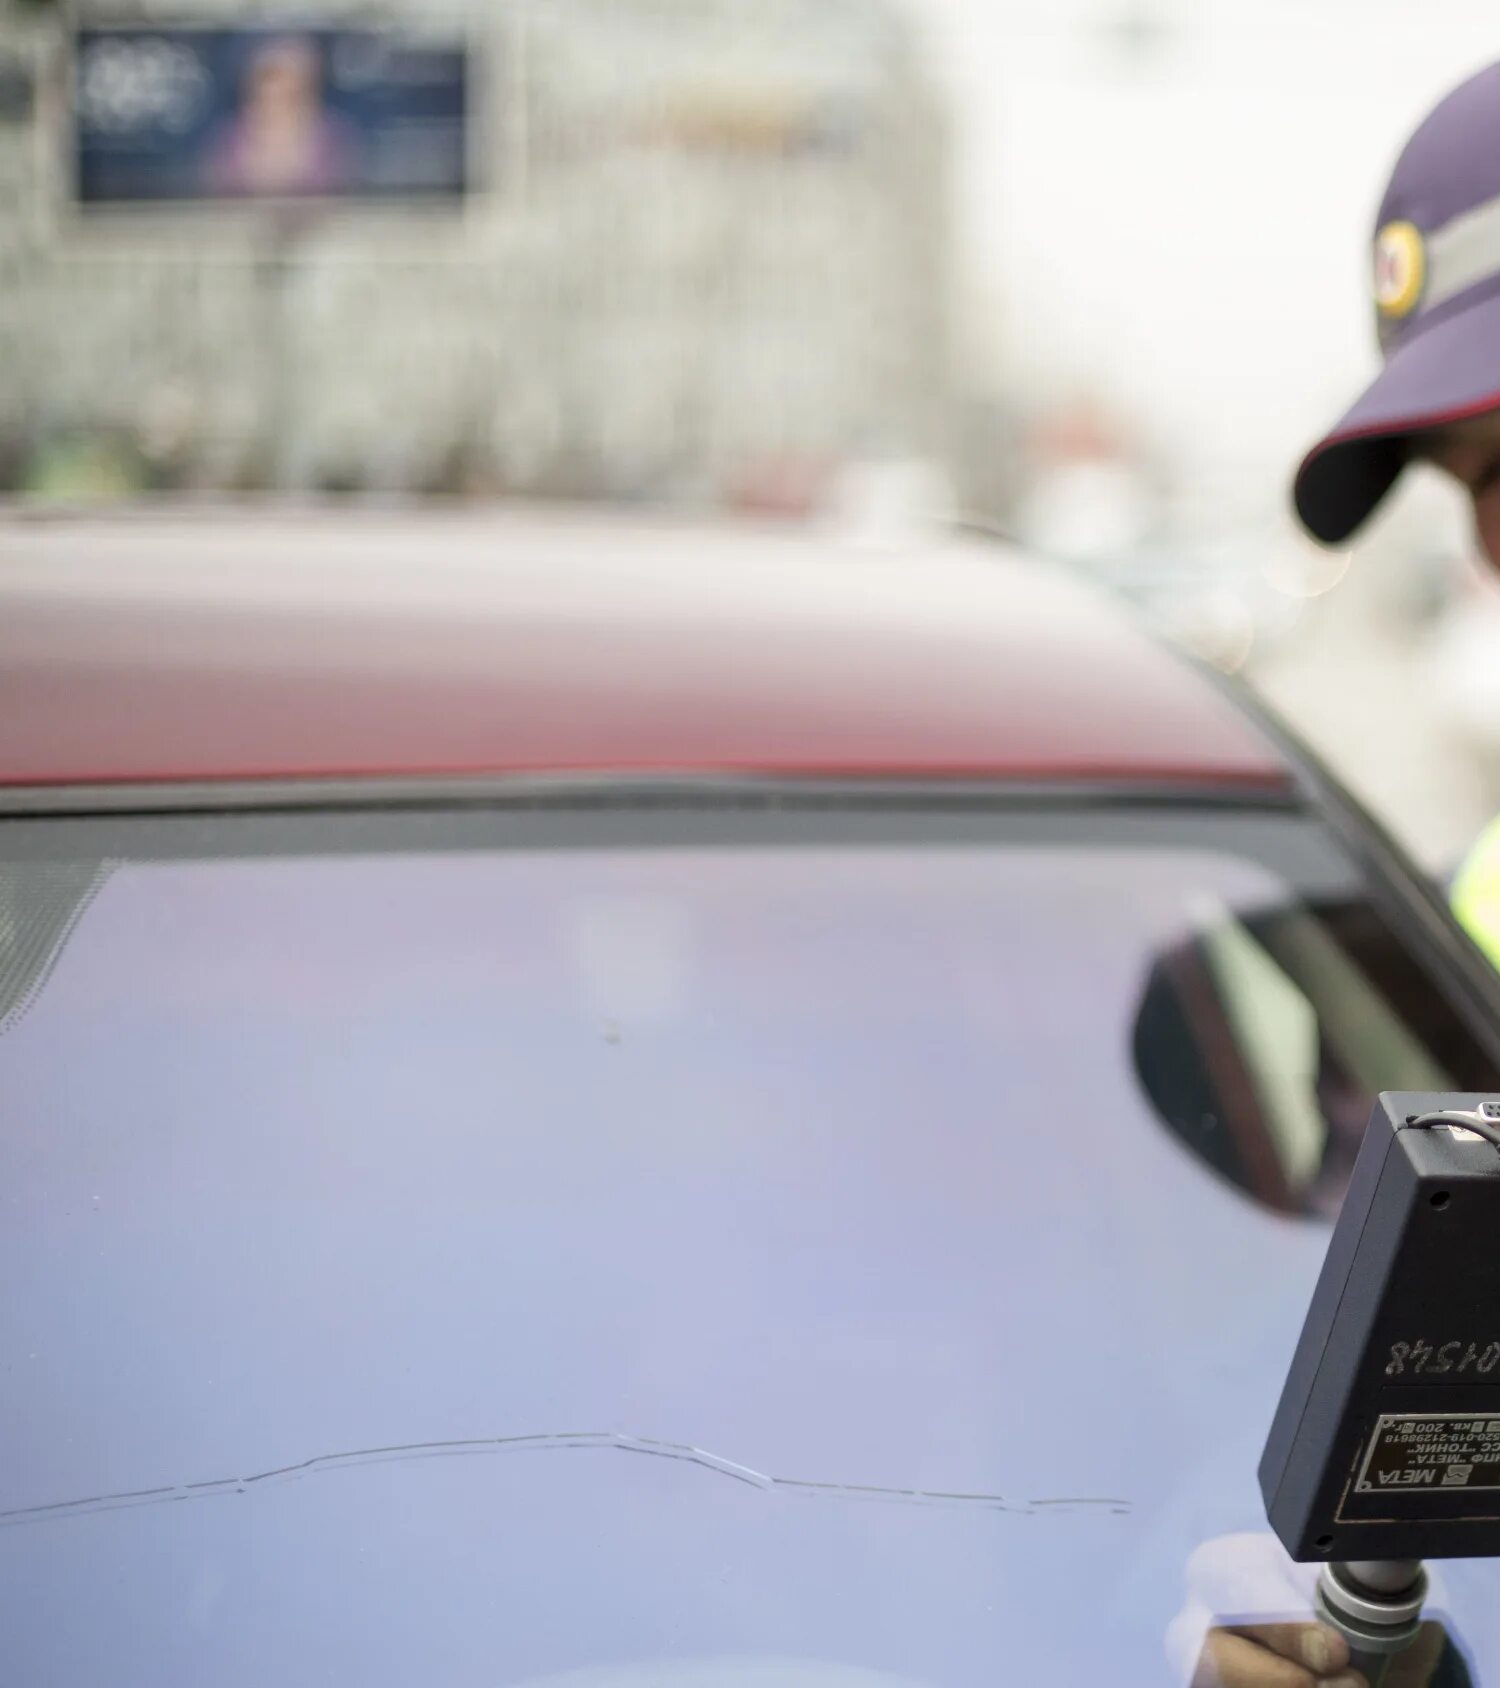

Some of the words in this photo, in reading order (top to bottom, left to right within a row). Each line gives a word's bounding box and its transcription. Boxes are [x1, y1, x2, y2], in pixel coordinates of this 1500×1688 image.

[1407, 1442, 1475, 1453] "ТОНИК"
[1407, 1453, 1466, 1465] "МЕТА"
[1378, 1468, 1437, 1485] МЕТА
